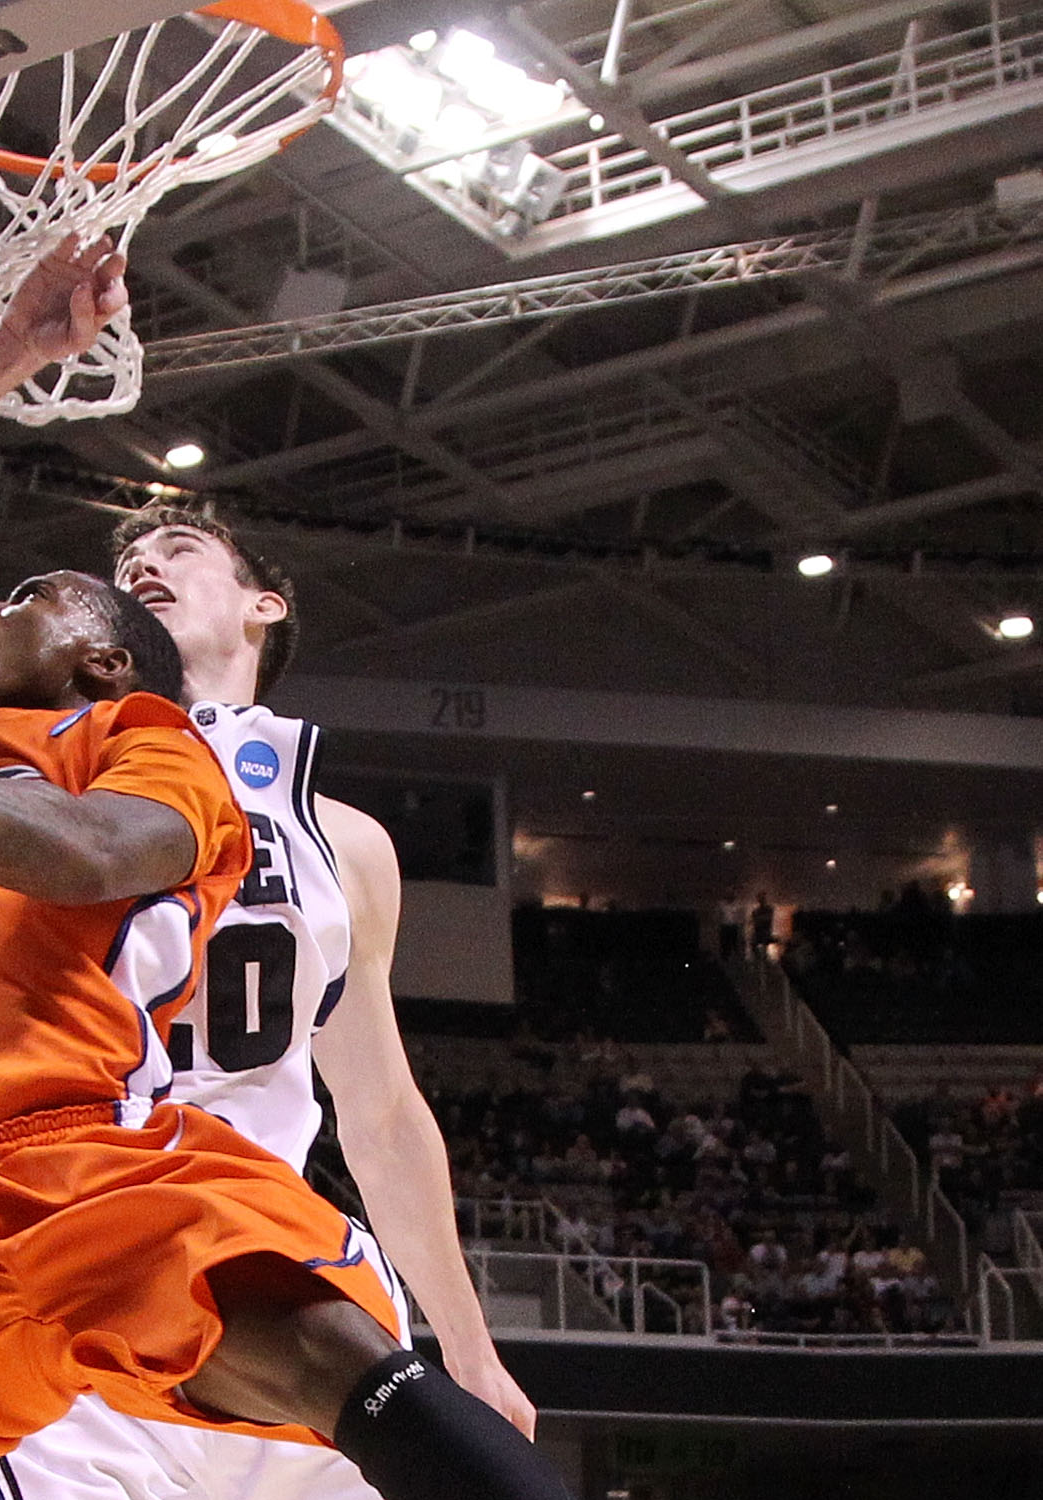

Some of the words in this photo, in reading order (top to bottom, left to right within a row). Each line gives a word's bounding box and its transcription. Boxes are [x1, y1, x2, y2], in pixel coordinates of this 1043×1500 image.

[431, 688, 486, 729] 219
[240, 760, 275, 779] NCAA
[169, 922, 296, 1073] 0
